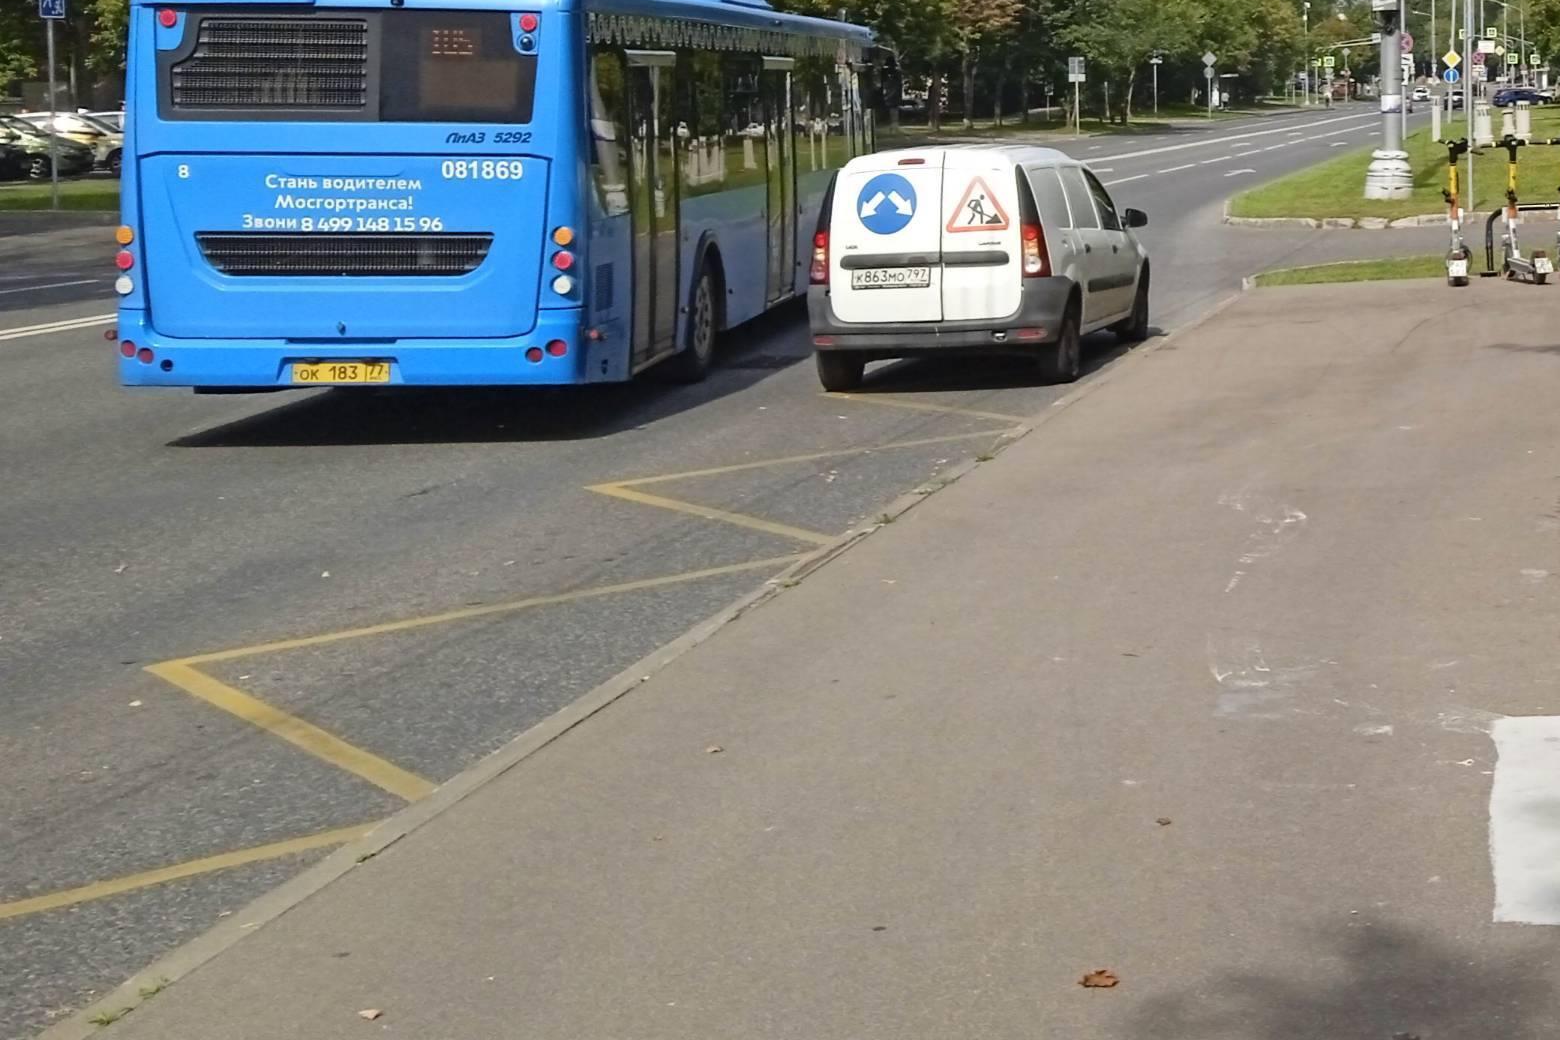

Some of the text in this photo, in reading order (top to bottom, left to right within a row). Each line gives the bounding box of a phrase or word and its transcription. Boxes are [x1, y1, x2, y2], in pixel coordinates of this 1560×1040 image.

[493, 131, 532, 144] 5292
[177, 165, 190, 178] 8
[441, 160, 523, 180] 081869
[265, 174, 421, 191] Стань водителем
[274, 195, 413, 211] Мосгортранса!
[242, 215, 443, 232] Звони 8 499 148 15 96
[328, 365, 359, 381] 183
